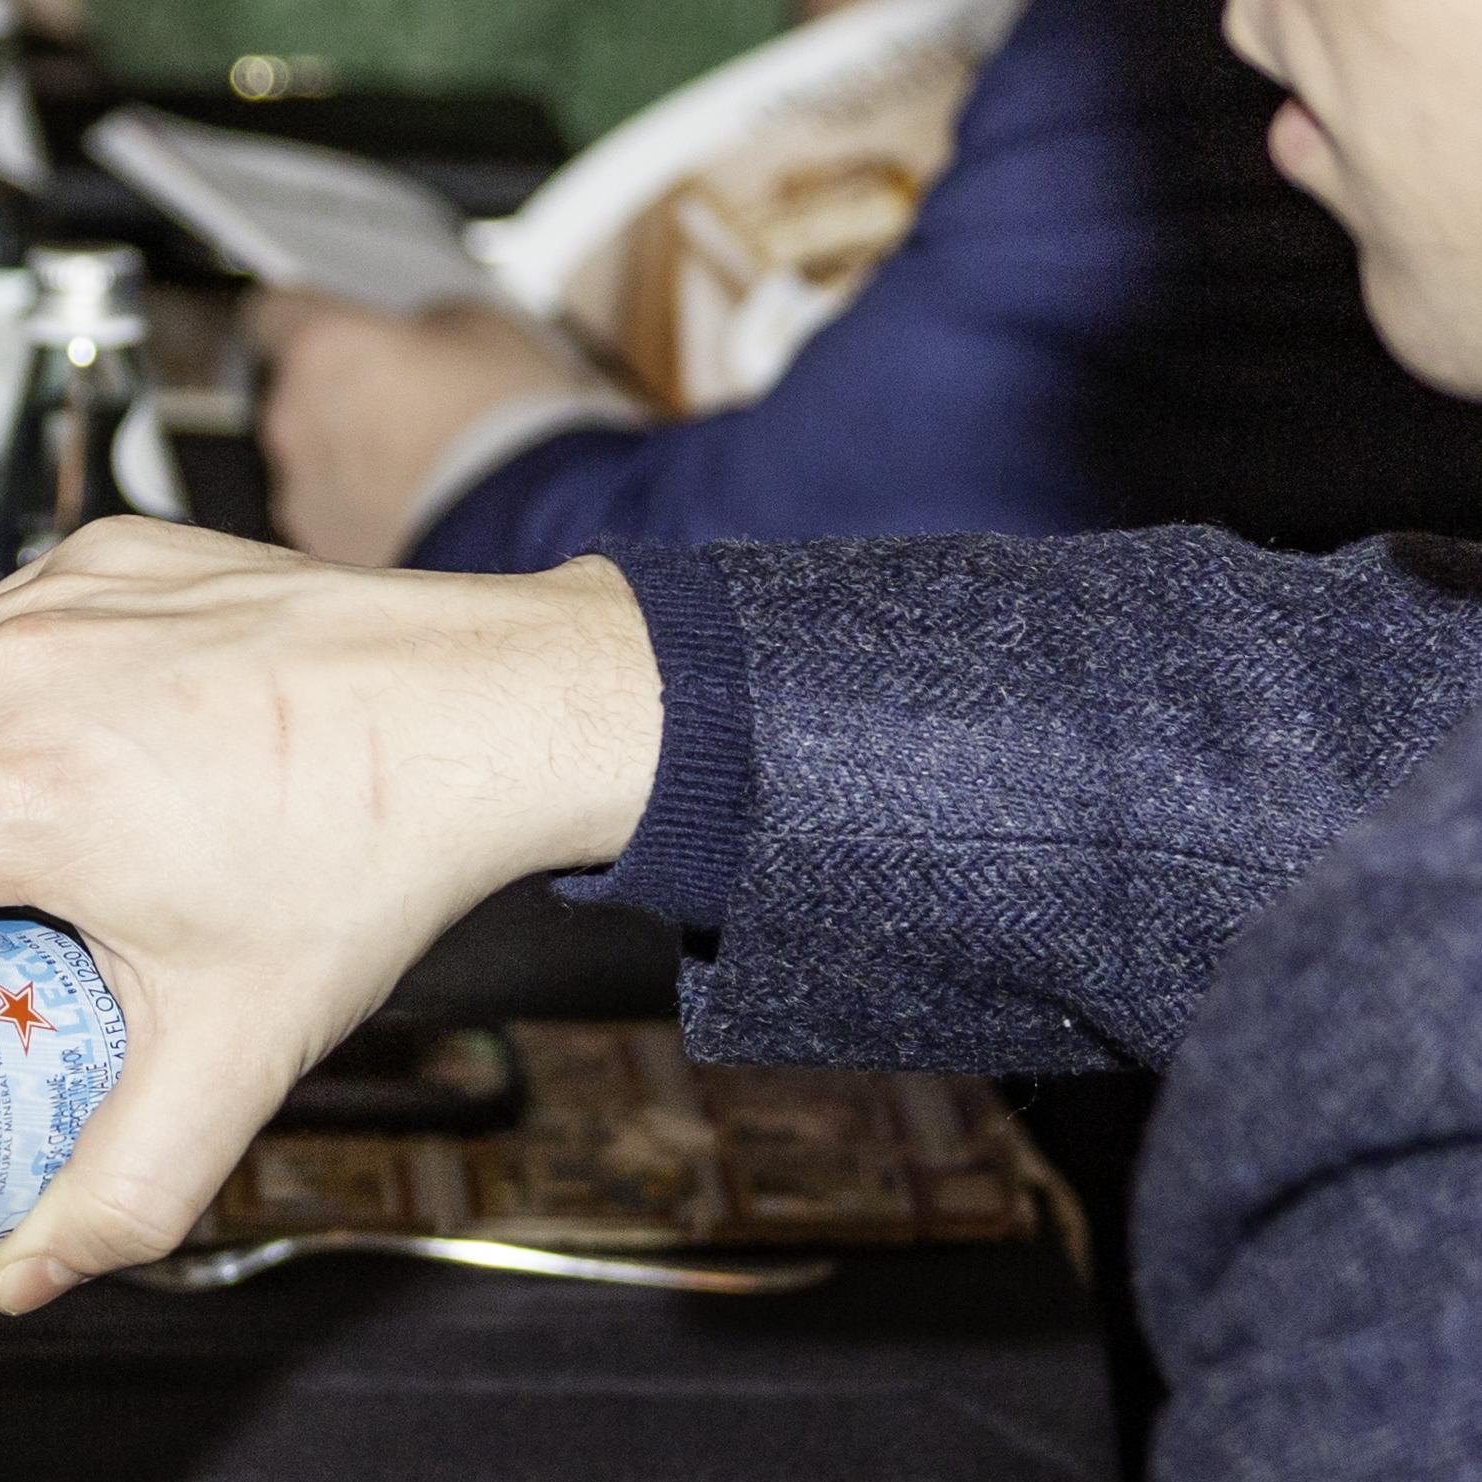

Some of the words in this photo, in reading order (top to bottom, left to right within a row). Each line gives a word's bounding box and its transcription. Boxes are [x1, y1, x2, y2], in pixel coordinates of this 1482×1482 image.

[55, 968, 76, 995] BEST
[88, 986, 114, 1013] OZ
[105, 1016, 124, 1041] FL
